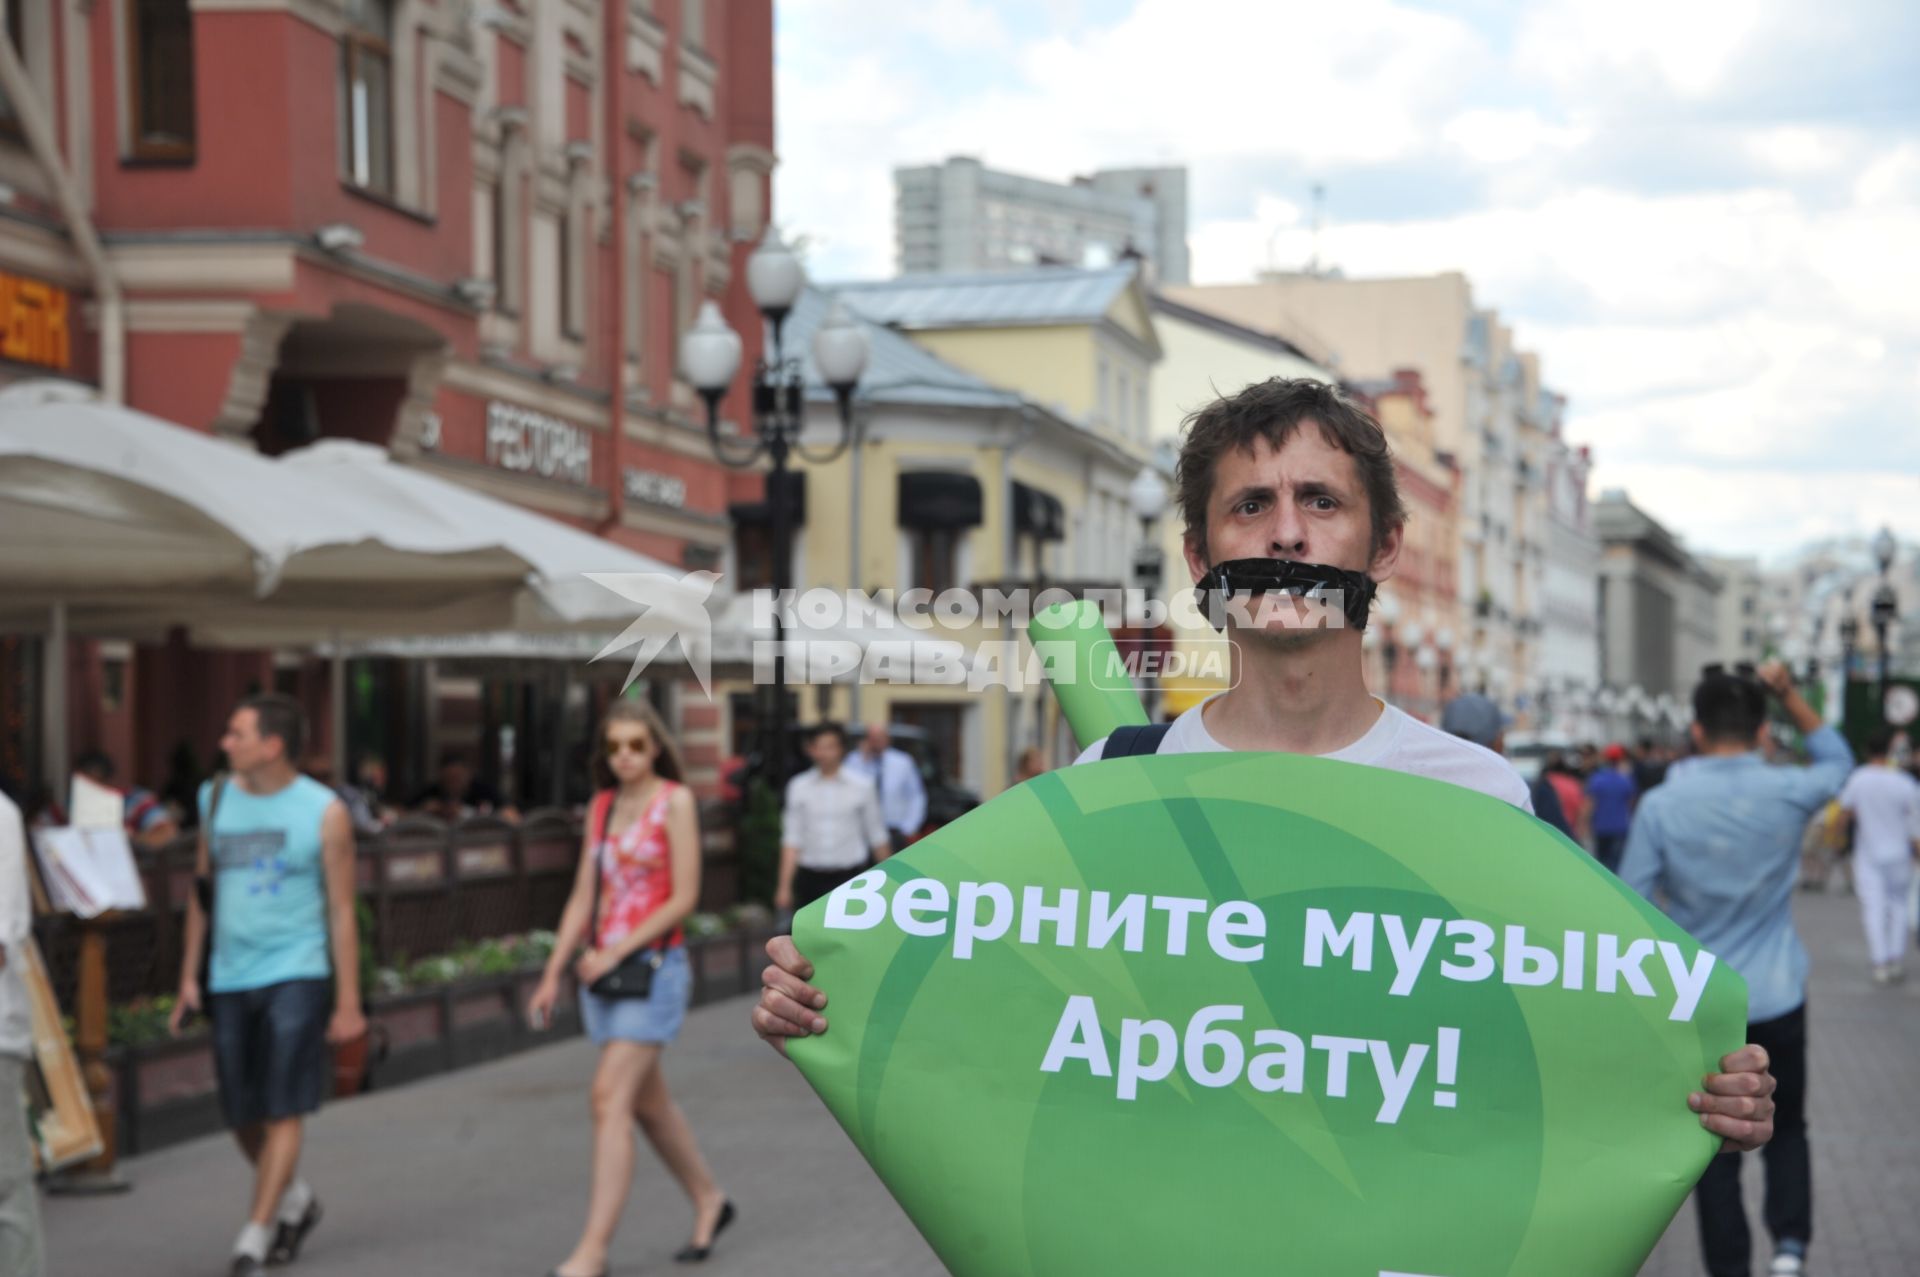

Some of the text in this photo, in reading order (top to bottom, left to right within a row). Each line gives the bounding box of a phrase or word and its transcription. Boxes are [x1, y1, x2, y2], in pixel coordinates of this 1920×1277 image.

[823, 869, 1716, 1021] Верните музыку
[1040, 995, 1459, 1123] Арбату!
